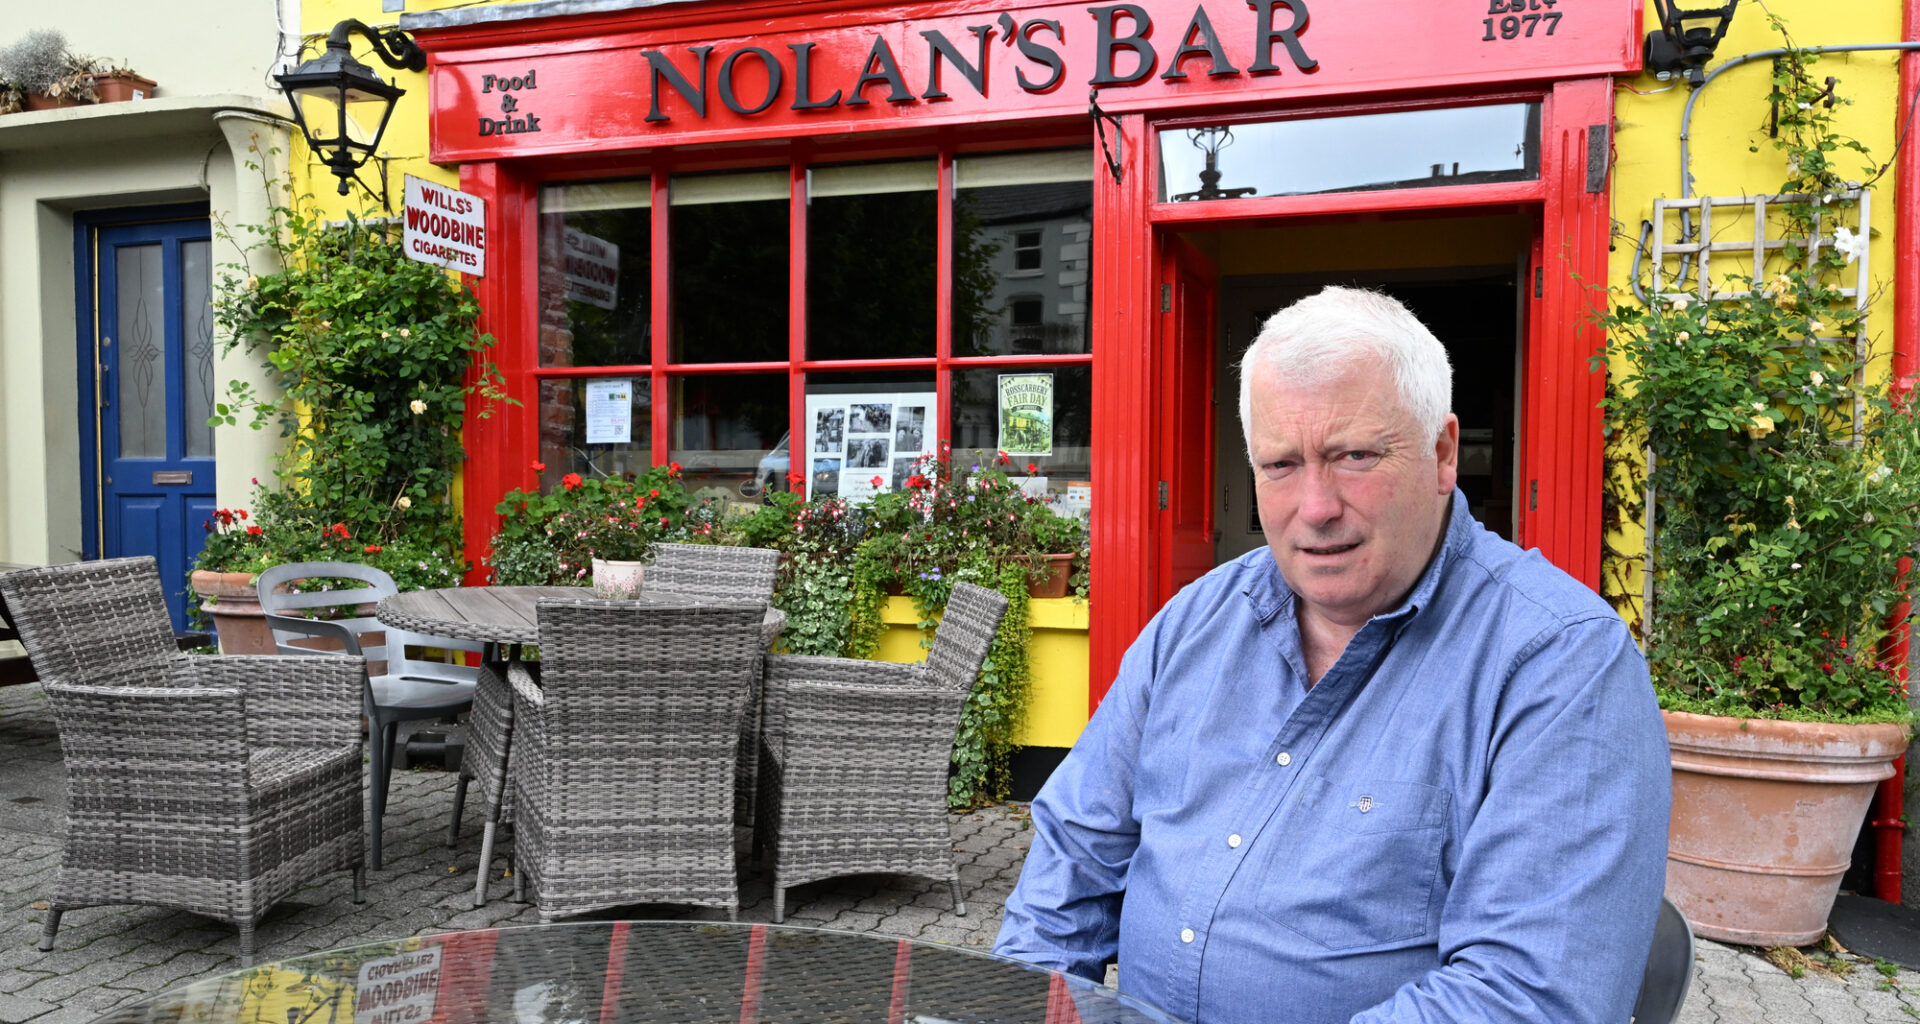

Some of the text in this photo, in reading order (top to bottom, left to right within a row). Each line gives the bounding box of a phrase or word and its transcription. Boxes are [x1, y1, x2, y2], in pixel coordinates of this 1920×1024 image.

[1482, 12, 1563, 41] 1977
[640, 0, 1318, 122] NOLAN'S BAR
[482, 69, 537, 93] Food
[501, 94, 519, 113] &
[478, 112, 541, 136] Drink
[407, 204, 484, 249] WOODBINE
[1007, 392, 1047, 407] FAIR DAY
